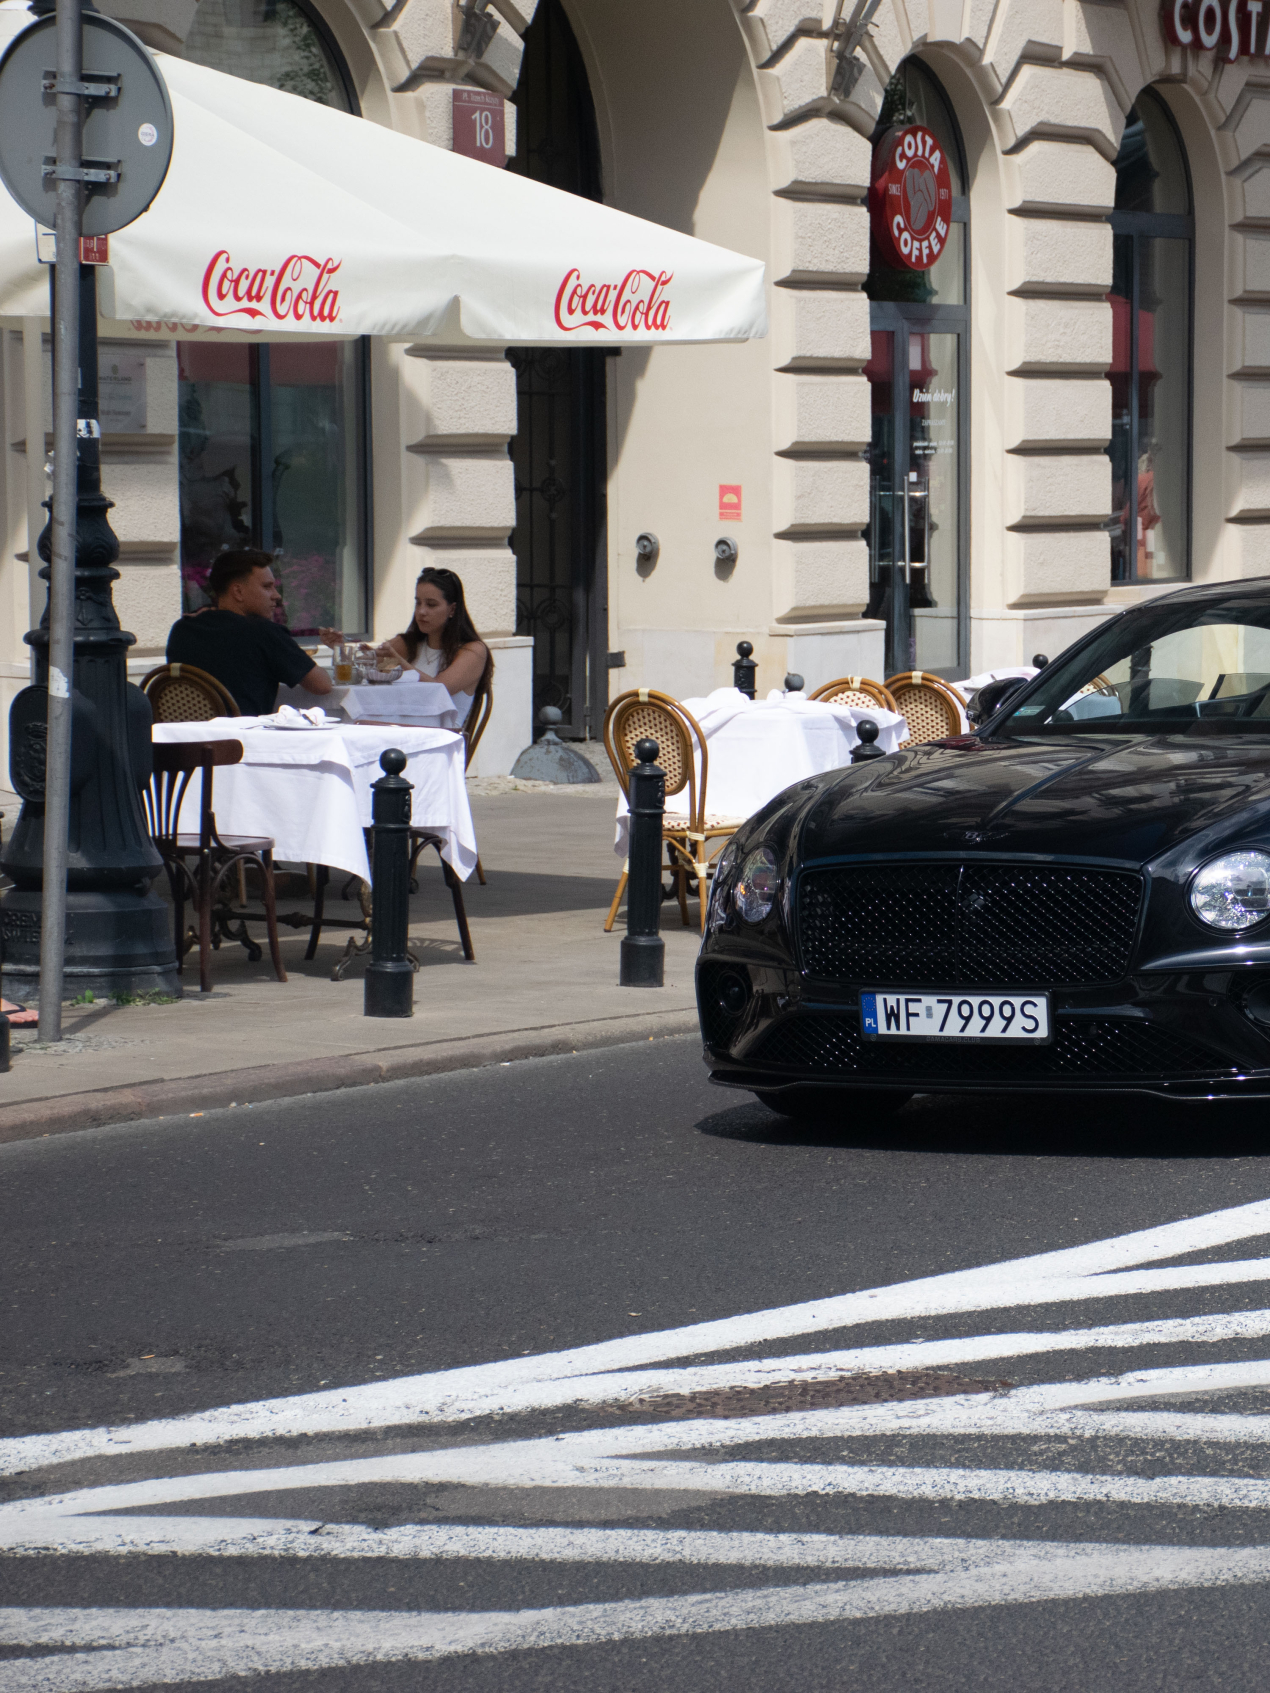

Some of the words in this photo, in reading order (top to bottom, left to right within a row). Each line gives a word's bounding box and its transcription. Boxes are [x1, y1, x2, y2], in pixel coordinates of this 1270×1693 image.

[471, 109, 493, 149] 18
[895, 131, 941, 174] COSTA
[888, 183, 902, 196] SINCE
[892, 215, 948, 264] COFFEE
[202, 249, 343, 323] Coca-Cola
[554, 267, 674, 333] Coca-Cola
[865, 1017, 877, 1028] PL
[882, 997, 923, 1032] WF
[936, 998, 1040, 1034] 7999S
